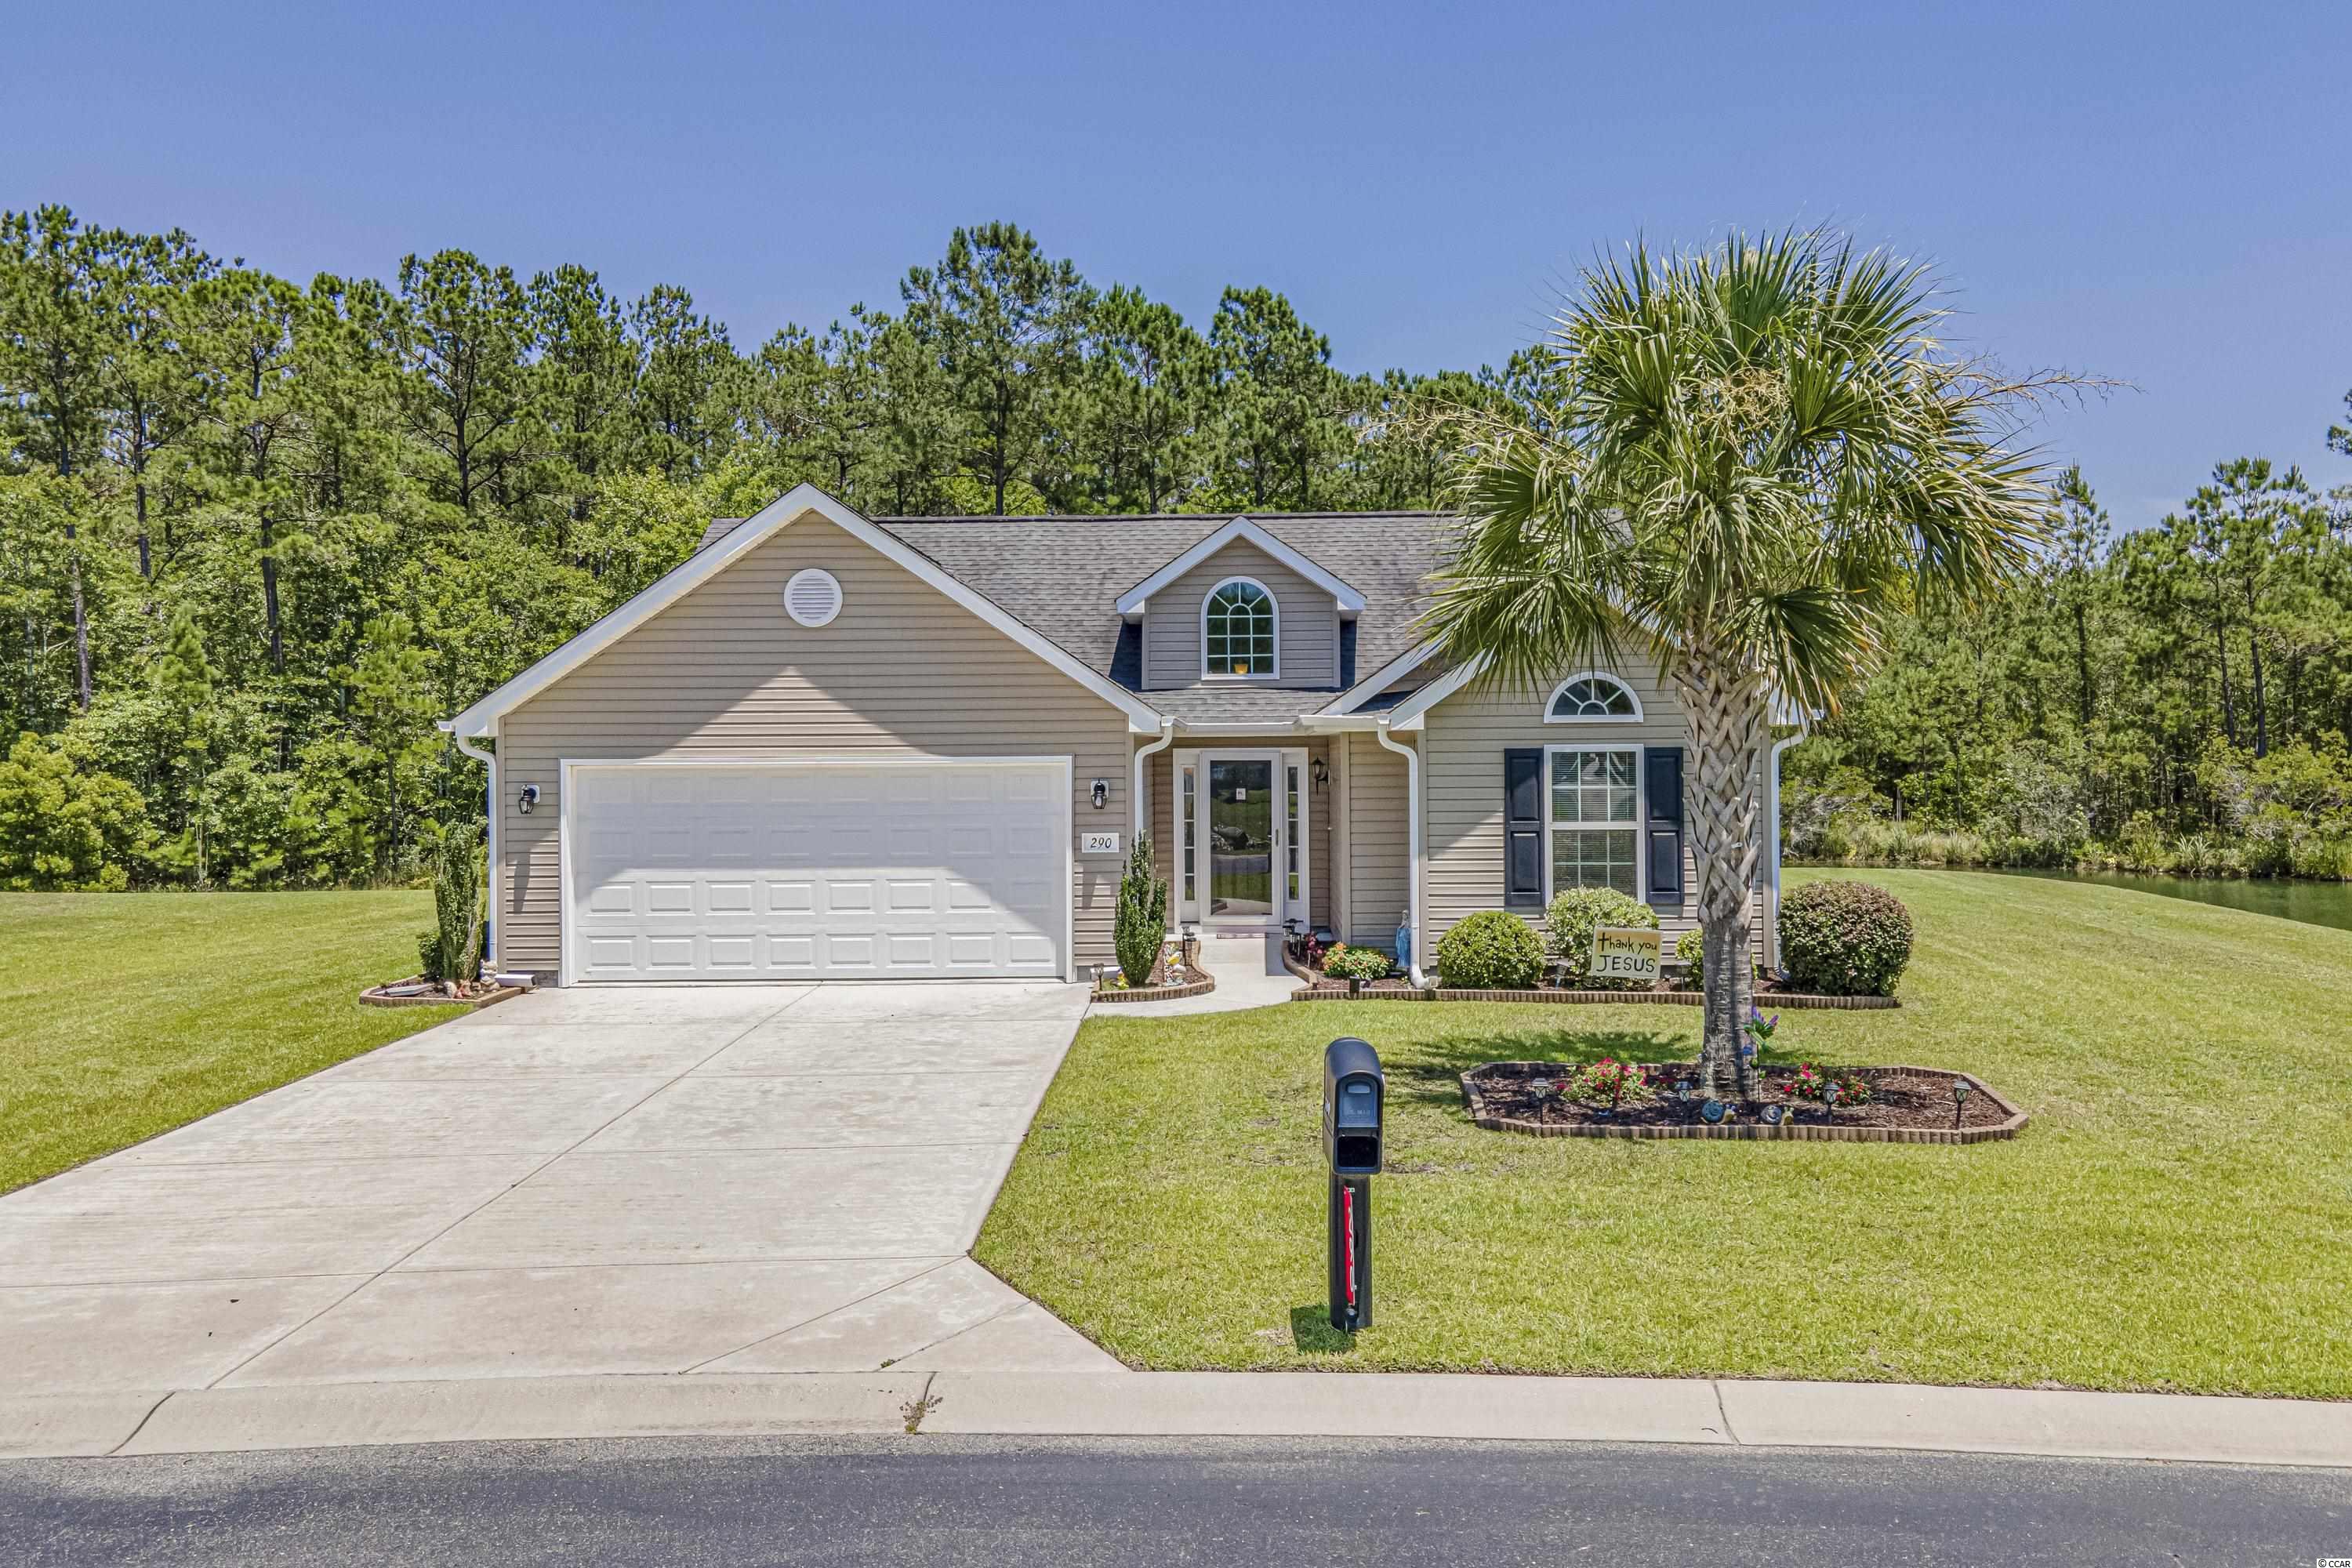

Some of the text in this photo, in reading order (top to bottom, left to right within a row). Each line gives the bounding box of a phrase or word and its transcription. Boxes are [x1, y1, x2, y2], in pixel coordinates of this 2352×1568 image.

[1091, 837, 1112, 848] 290
[1637, 942, 1657, 955] you
[1596, 955, 1656, 973] JESUS
